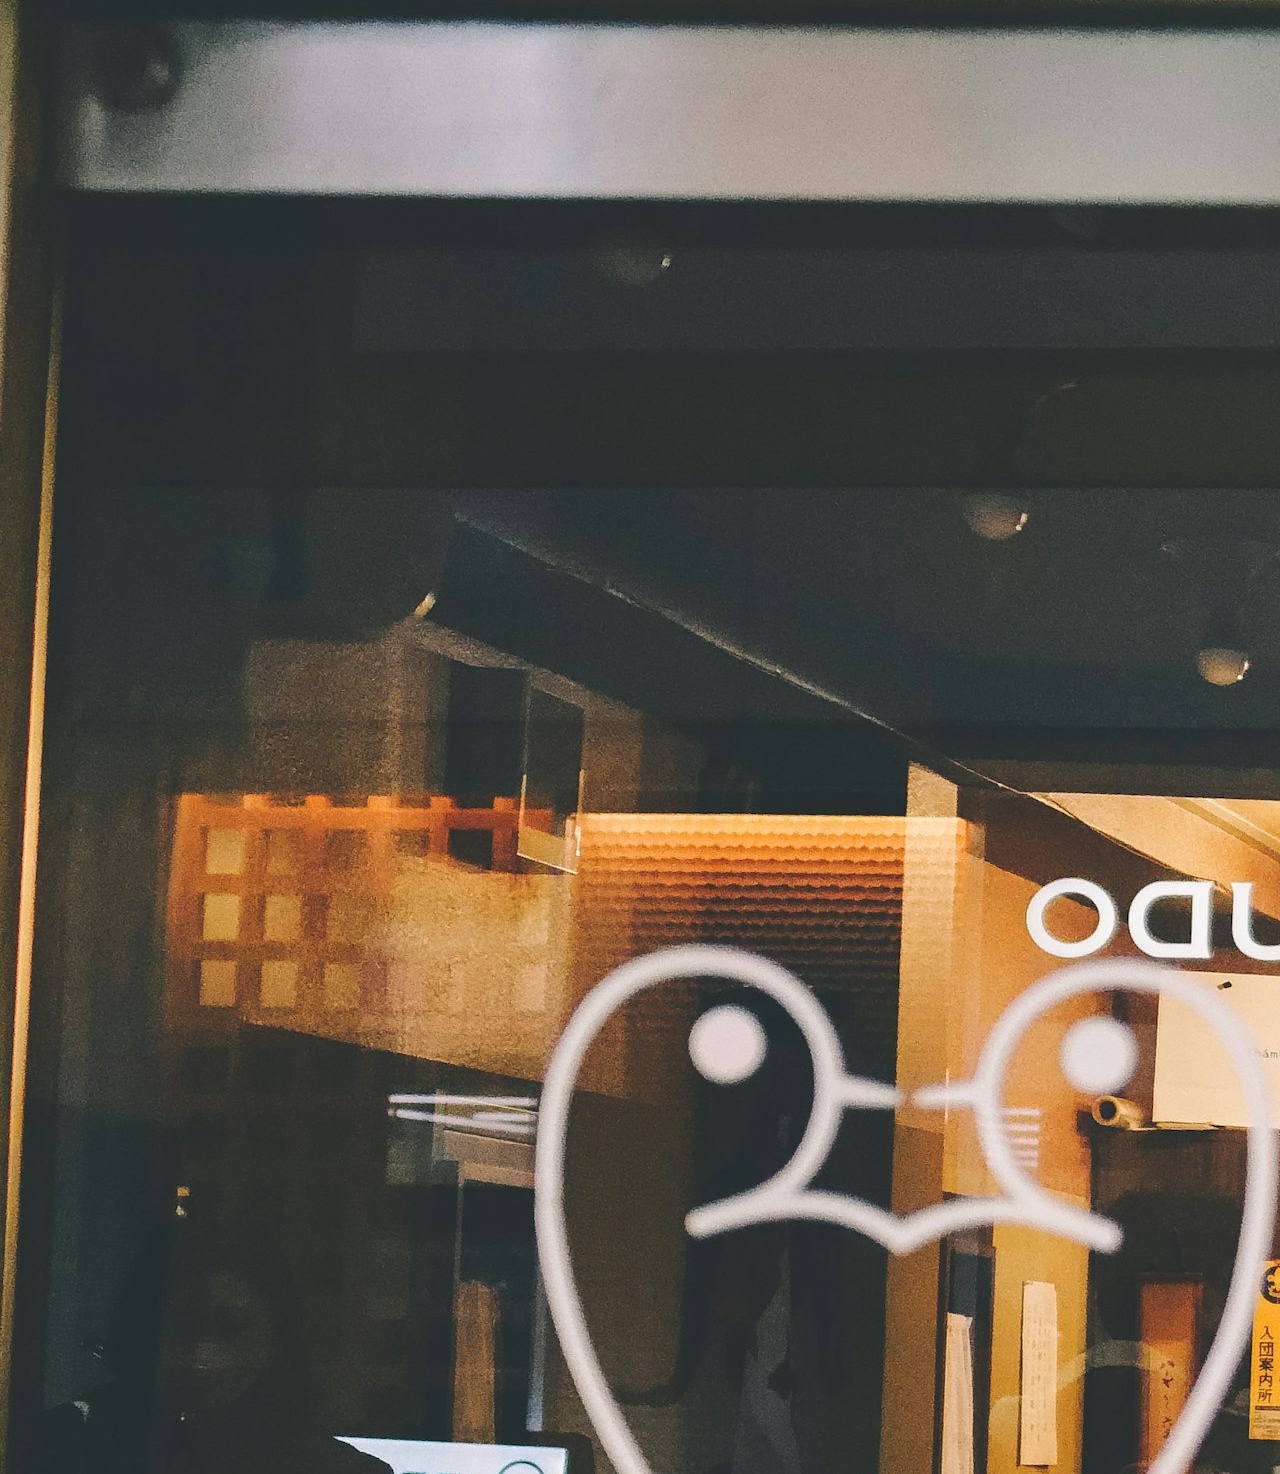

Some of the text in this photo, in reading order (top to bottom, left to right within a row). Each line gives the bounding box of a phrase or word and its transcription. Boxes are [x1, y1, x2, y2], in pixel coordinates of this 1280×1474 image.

[1257, 1325, 1274, 1404] 入団案内所
